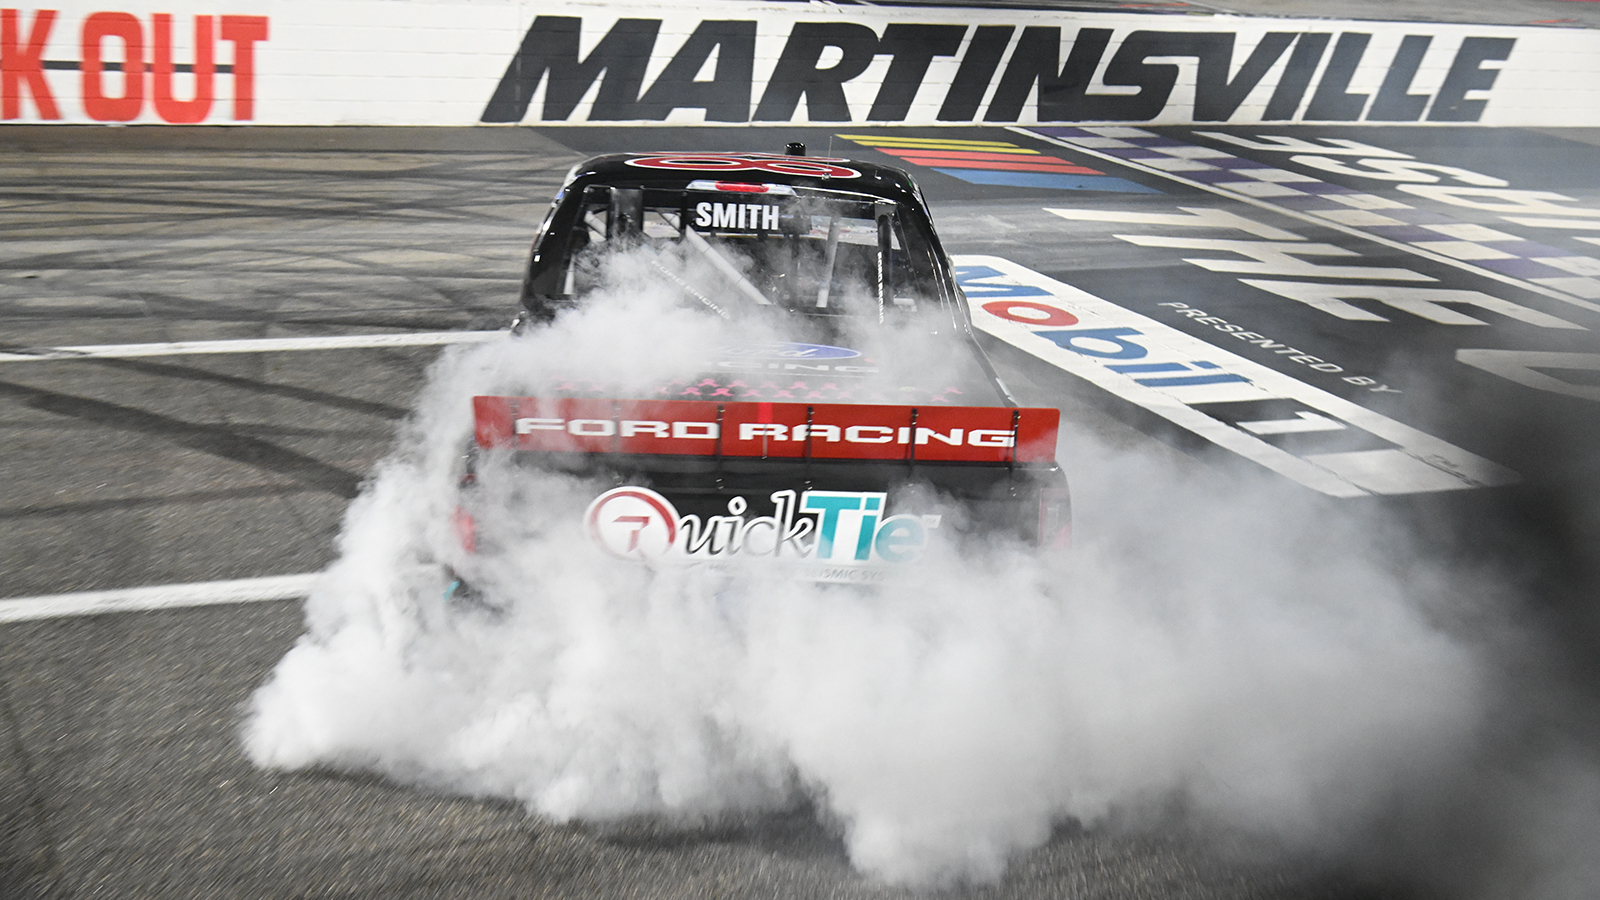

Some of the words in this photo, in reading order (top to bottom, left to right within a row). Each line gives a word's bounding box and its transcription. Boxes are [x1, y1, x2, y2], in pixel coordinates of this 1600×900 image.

[81, 11, 269, 123] OUT
[479, 15, 1517, 122] MARTINSVILLE
[696, 202, 780, 231] SMITH
[1042, 206, 1590, 331] THE
[954, 265, 1253, 388] Mobil
[1157, 302, 1345, 374] PRESENTED
[1342, 376, 1403, 394] BY
[515, 417, 720, 439] FORD
[738, 422, 1016, 447] RACING
[585, 487, 923, 562] QuickTie
